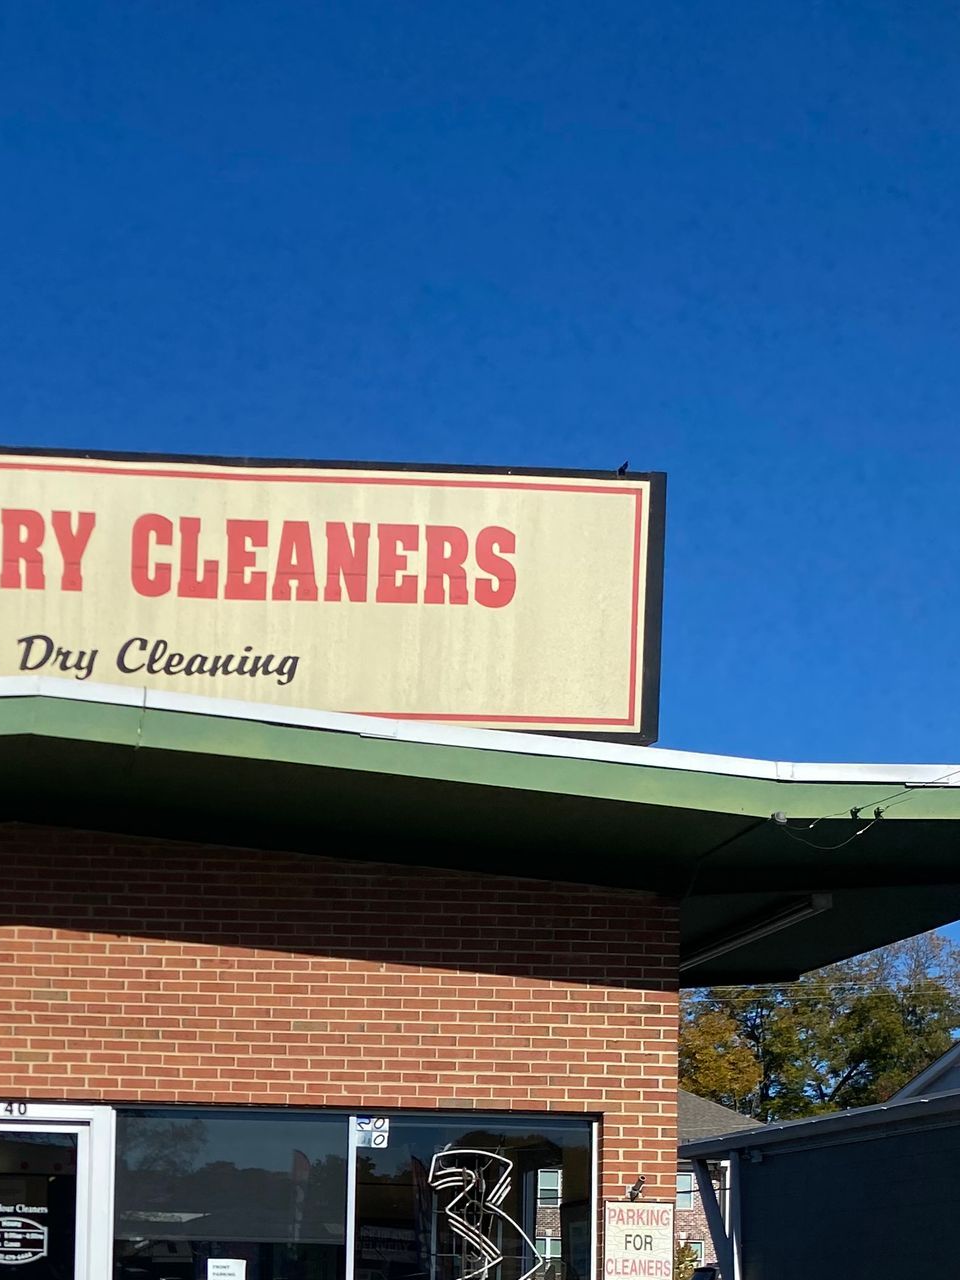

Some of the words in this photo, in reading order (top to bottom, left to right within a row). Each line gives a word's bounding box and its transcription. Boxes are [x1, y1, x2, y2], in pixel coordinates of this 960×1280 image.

[131, 513, 517, 608] CLEANERS
[17, 634, 99, 681] Dry
[115, 636, 301, 685] Cleaning
[15, 1204, 48, 1213] Cleaners
[607, 1207, 670, 1226] PARKING
[624, 1233, 653, 1251] FOR
[605, 1258, 671, 1277] CLEANERS
